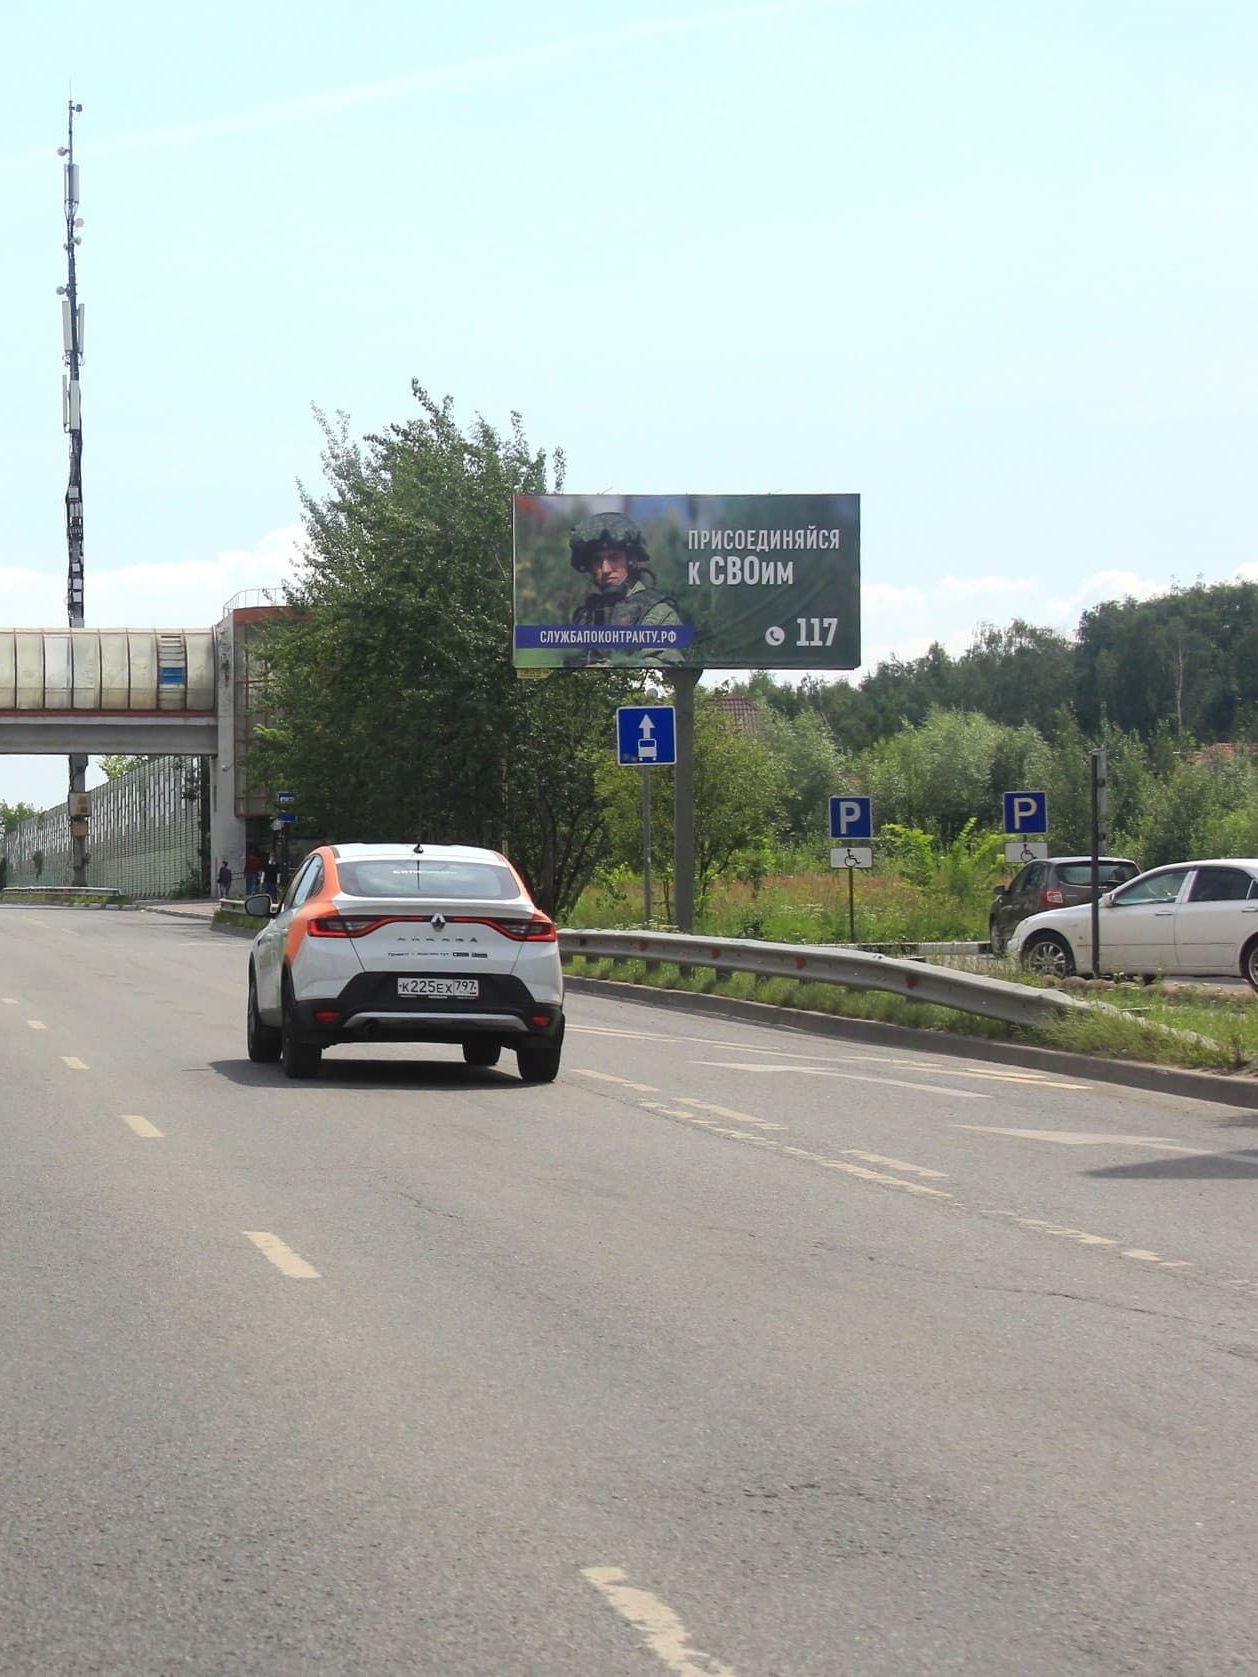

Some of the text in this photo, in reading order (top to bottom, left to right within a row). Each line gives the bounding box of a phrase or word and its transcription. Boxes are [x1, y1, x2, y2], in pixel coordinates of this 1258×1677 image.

[688, 526, 840, 552] ПРИСОЕДИНЯЙСЯ
[540, 630, 677, 644] СЛУЖБАПОКОНТРАКТУ.РФ
[796, 617, 839, 647] 117
[839, 802, 861, 834] P
[1014, 797, 1037, 830] P
[455, 980, 475, 991] 797
